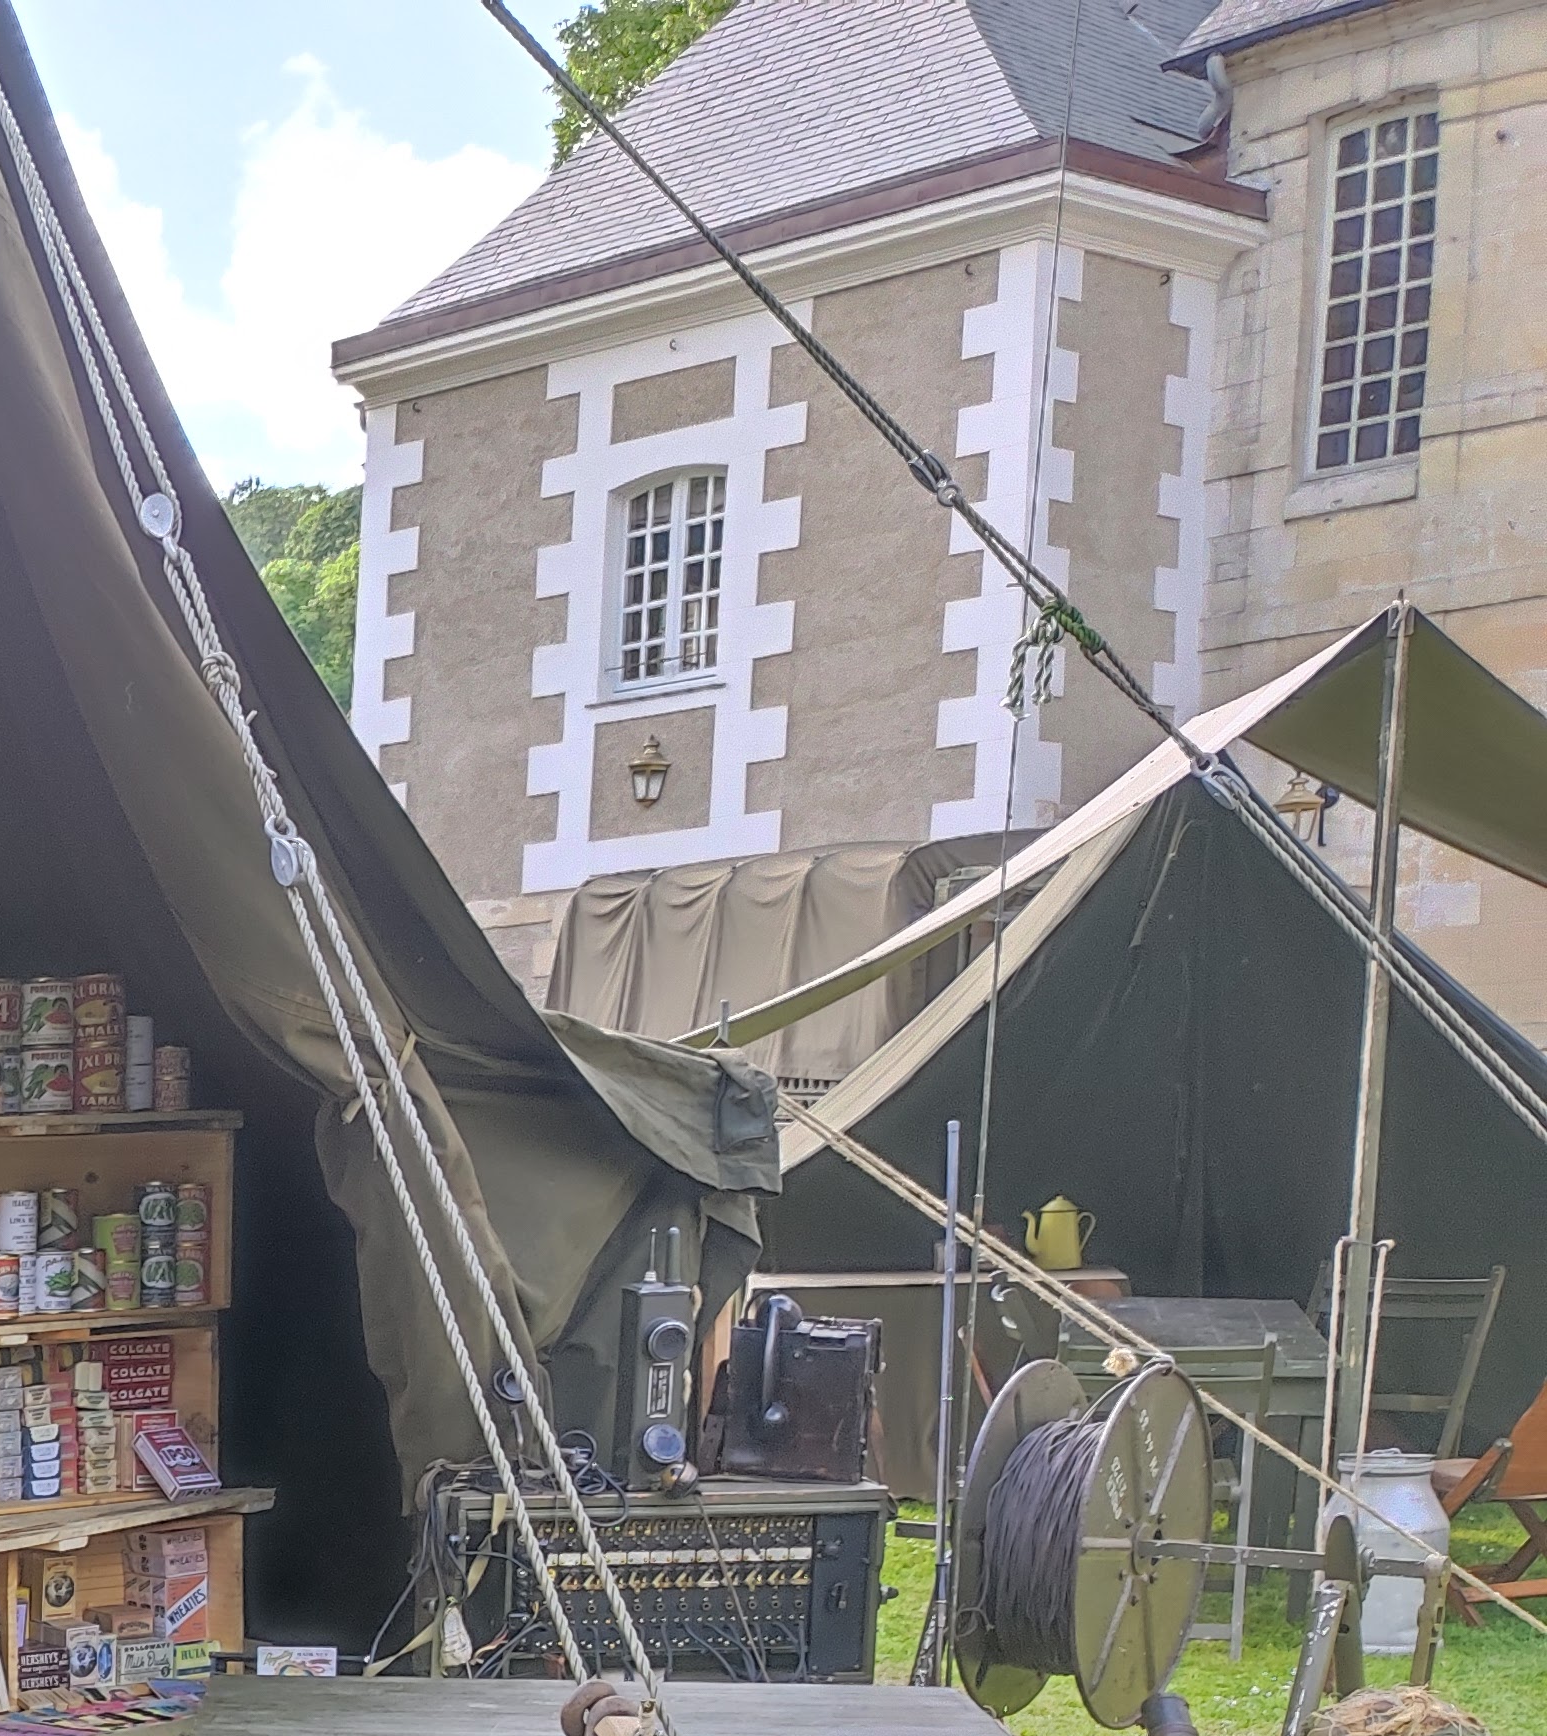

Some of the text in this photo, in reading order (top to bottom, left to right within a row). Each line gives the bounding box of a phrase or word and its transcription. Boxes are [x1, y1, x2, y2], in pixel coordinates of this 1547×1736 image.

[109, 1343, 170, 1355] COLGATE
[110, 1365, 170, 1378] COLGATE
[109, 1386, 169, 1401] COLGATE
[160, 1446, 199, 1466] IPSO
[166, 1532, 203, 1546] WHEATIES
[168, 1553, 205, 1566] WHEATIES
[167, 1588, 207, 1627] WHEATIES
